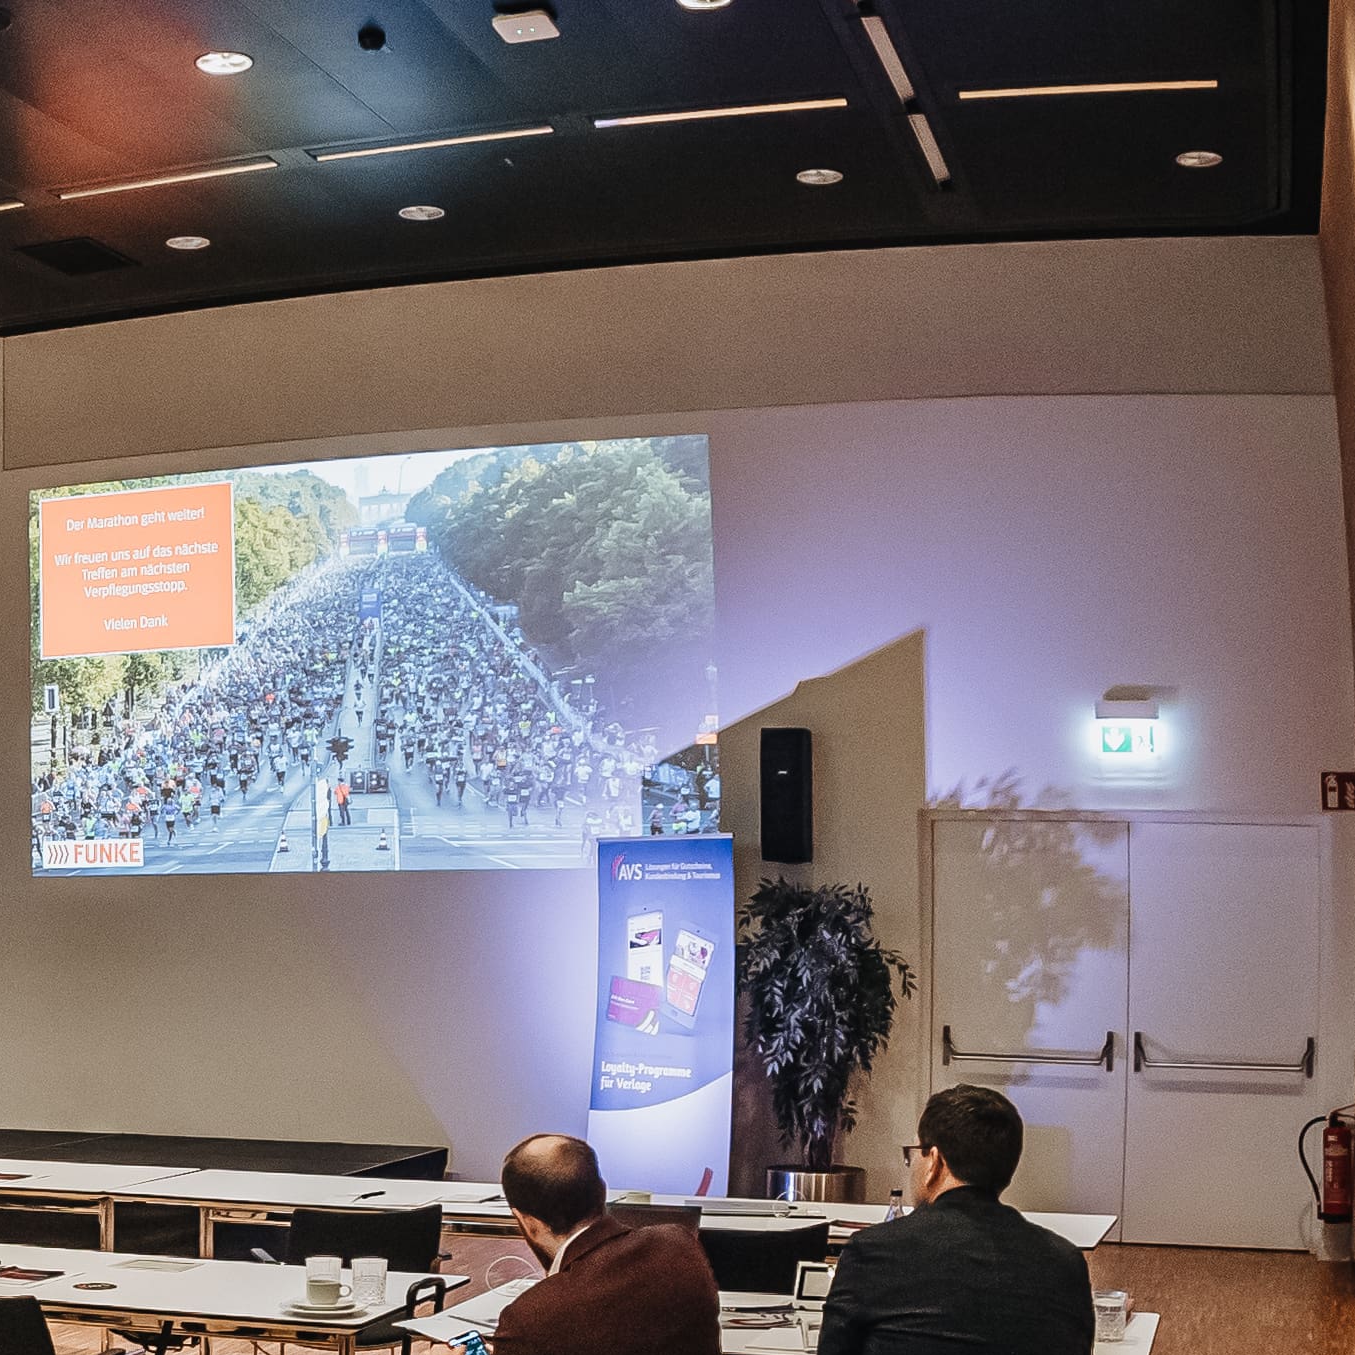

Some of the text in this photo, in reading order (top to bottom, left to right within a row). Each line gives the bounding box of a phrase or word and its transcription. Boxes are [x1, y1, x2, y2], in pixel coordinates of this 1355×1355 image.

[66, 507, 205, 531] Der Marathon geht weiter!
[54, 541, 219, 567] Wir freuen uns auf das nächste
[82, 561, 190, 581] Treffen am nächsten
[84, 579, 188, 599] Verpflegungsstopp.
[103, 614, 168, 631] Vielen Dank
[74, 842, 141, 864] FUNKE
[618, 863, 643, 881] AVS
[601, 1060, 692, 1079] Loyalty-Programme
[600, 1075, 652, 1094] für Verlage
